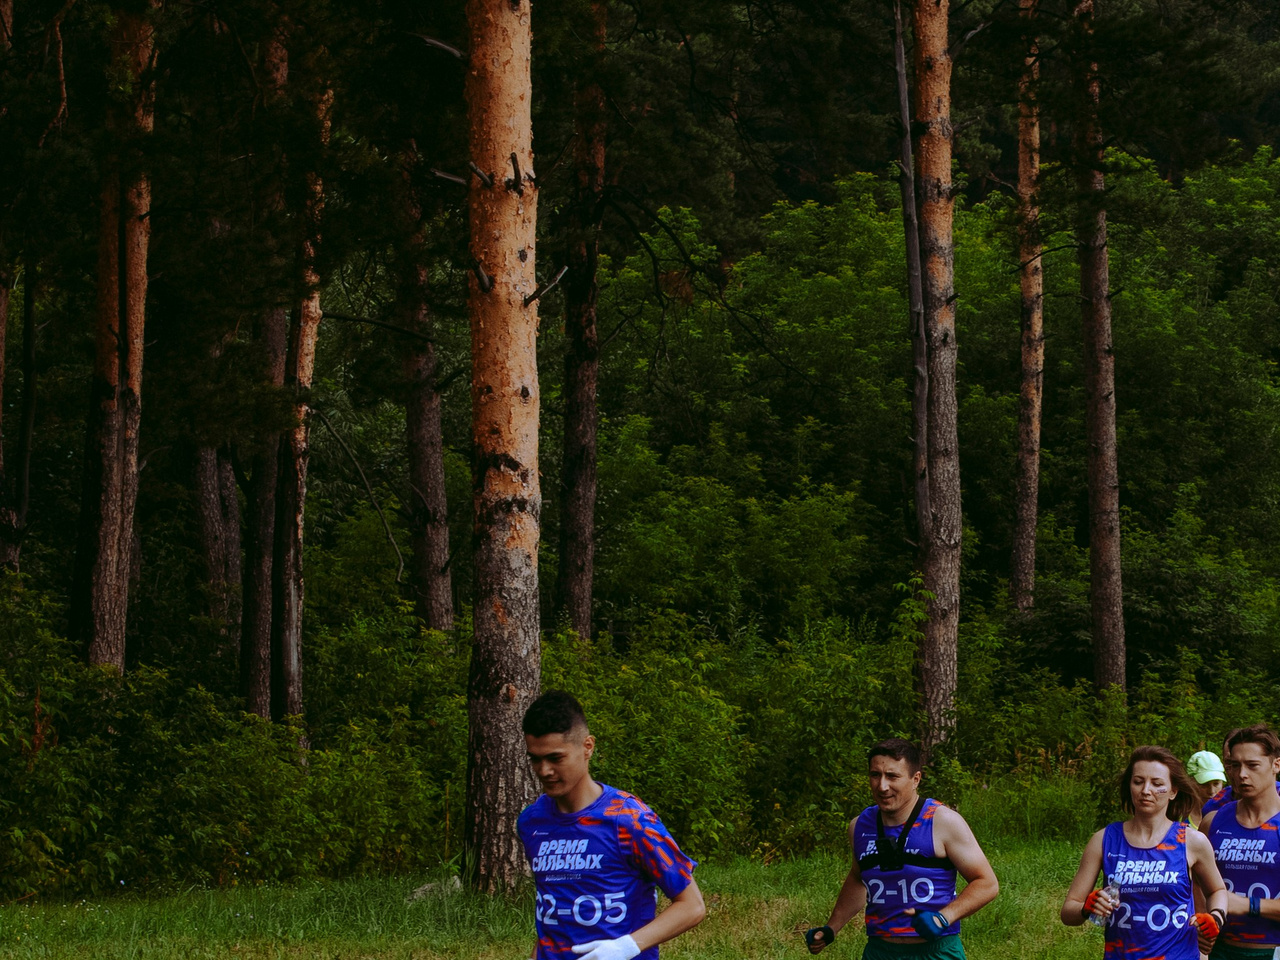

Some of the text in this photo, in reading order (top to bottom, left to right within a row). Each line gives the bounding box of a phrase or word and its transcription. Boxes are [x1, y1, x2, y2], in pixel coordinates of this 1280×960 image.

[538, 839, 589, 856] ВРЕМЯ
[1219, 838, 1266, 850] ВРЕМЯ
[532, 854, 604, 872] СИЛЬНЫХ
[1214, 849, 1277, 864] СИЛЬНЫХ
[1115, 860, 1167, 873] ВРЕМЯ
[1107, 871, 1179, 886] СИЛЬНЫХ
